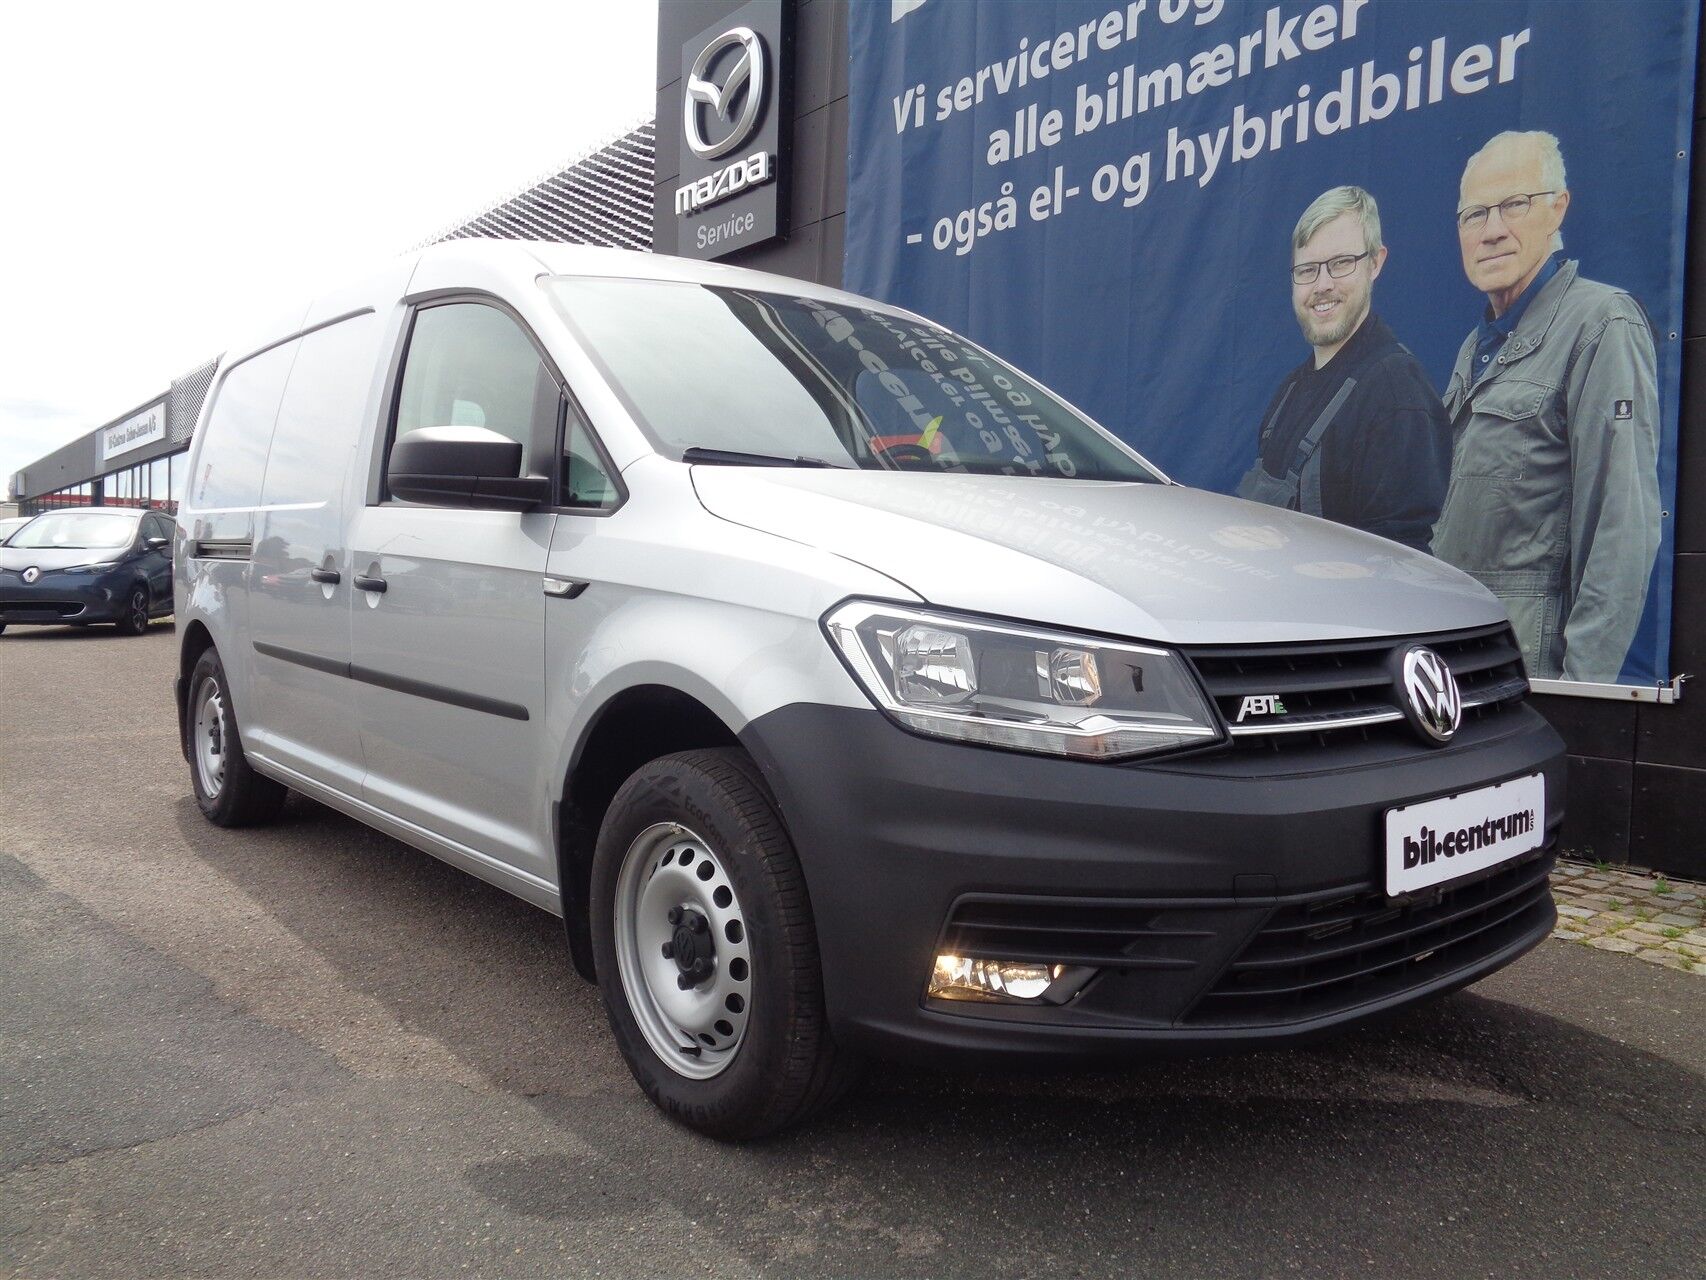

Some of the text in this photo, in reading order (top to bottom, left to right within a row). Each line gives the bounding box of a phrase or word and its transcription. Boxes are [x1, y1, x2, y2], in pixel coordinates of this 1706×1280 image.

[893, 83, 926, 135] Vi
[935, 0, 1147, 121] servicerer
[932, 181, 1017, 256] også
[1029, 165, 1080, 222] el-
[1091, 151, 1150, 208] og
[1166, 28, 1531, 188] hybridbiler
[986, 0, 1369, 166] alle bilmærker
[696, 212, 754, 249] Service
